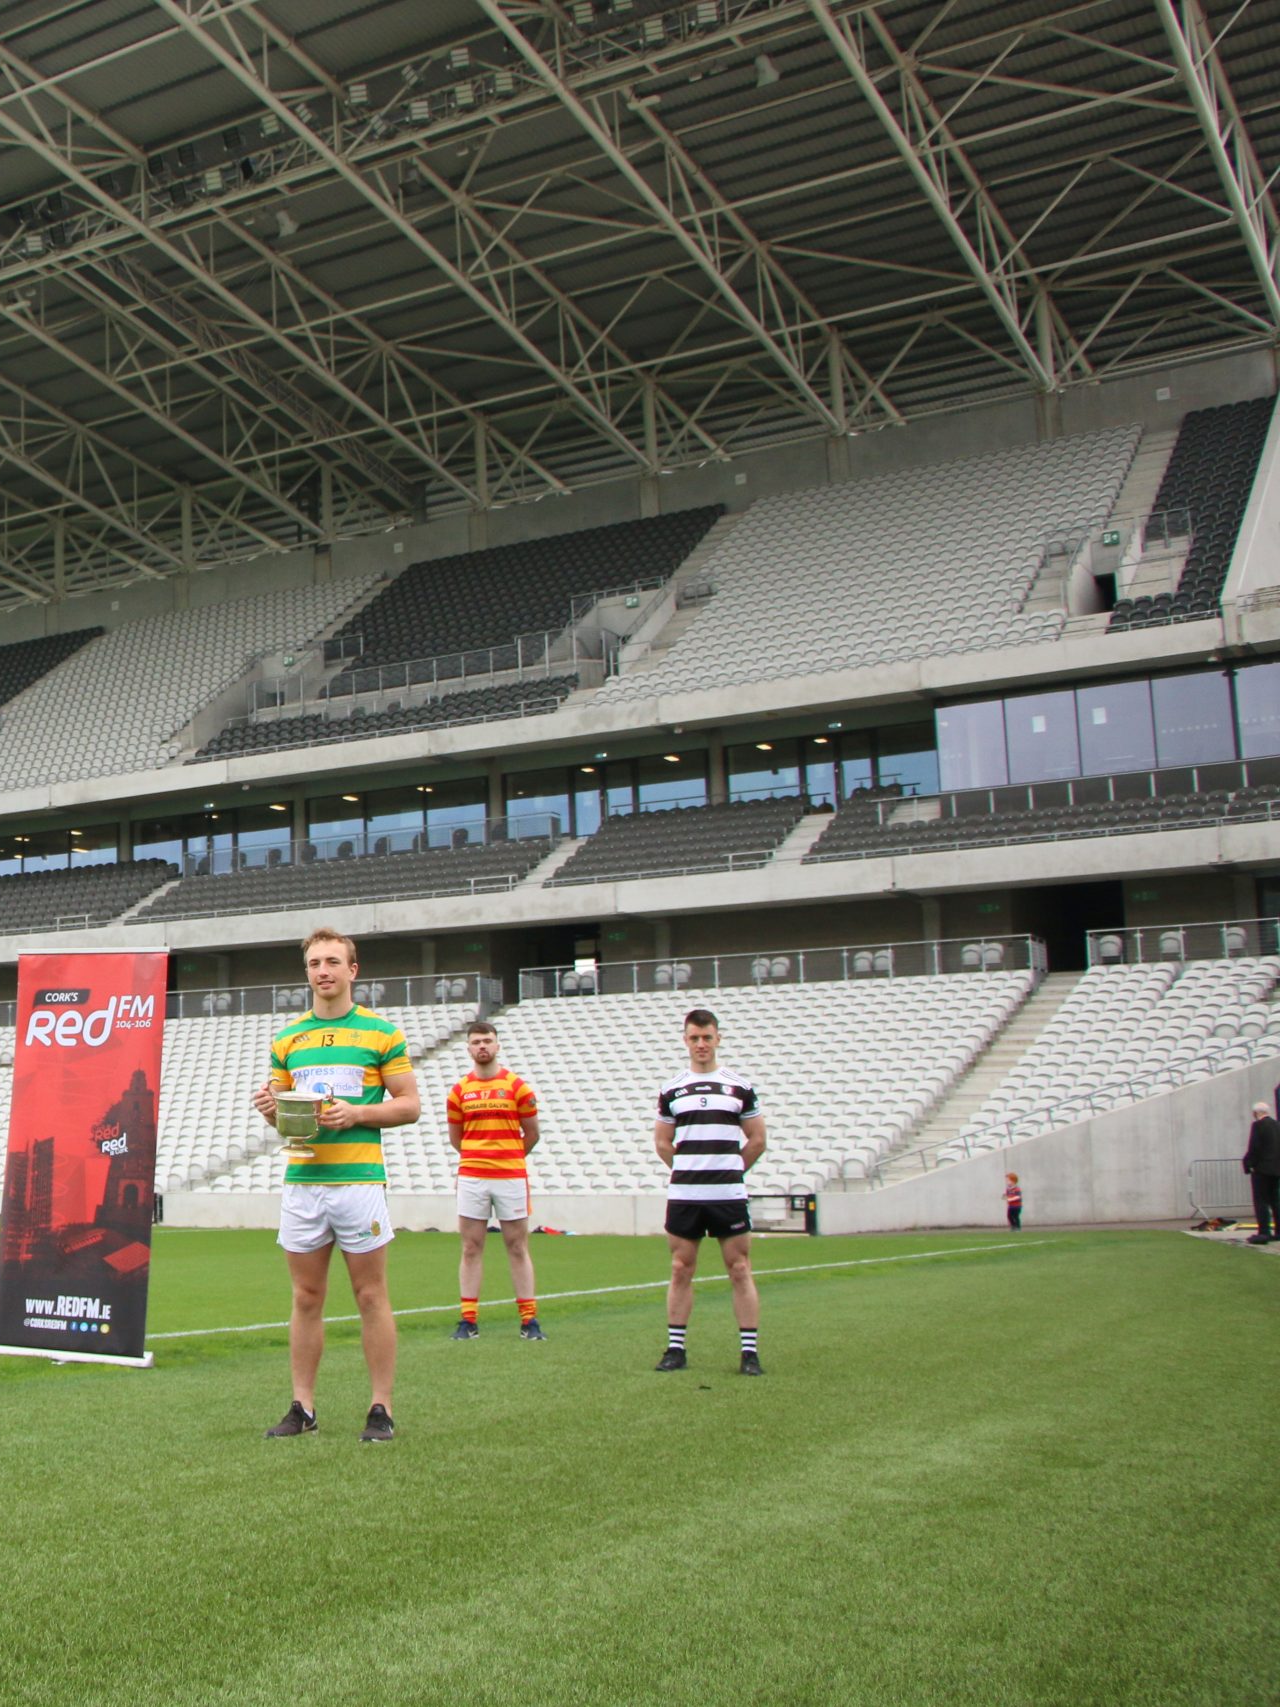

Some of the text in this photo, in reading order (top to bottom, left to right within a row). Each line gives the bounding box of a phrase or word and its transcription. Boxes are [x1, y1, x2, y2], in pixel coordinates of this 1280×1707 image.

[45, 992, 79, 1003] CORK'S
[25, 995, 155, 1047] Red FM
[115, 1019, 152, 1029] 104-106
[321, 1034, 334, 1047] 13
[699, 1097, 708, 1107] 9
[101, 1132, 127, 1153] Red
